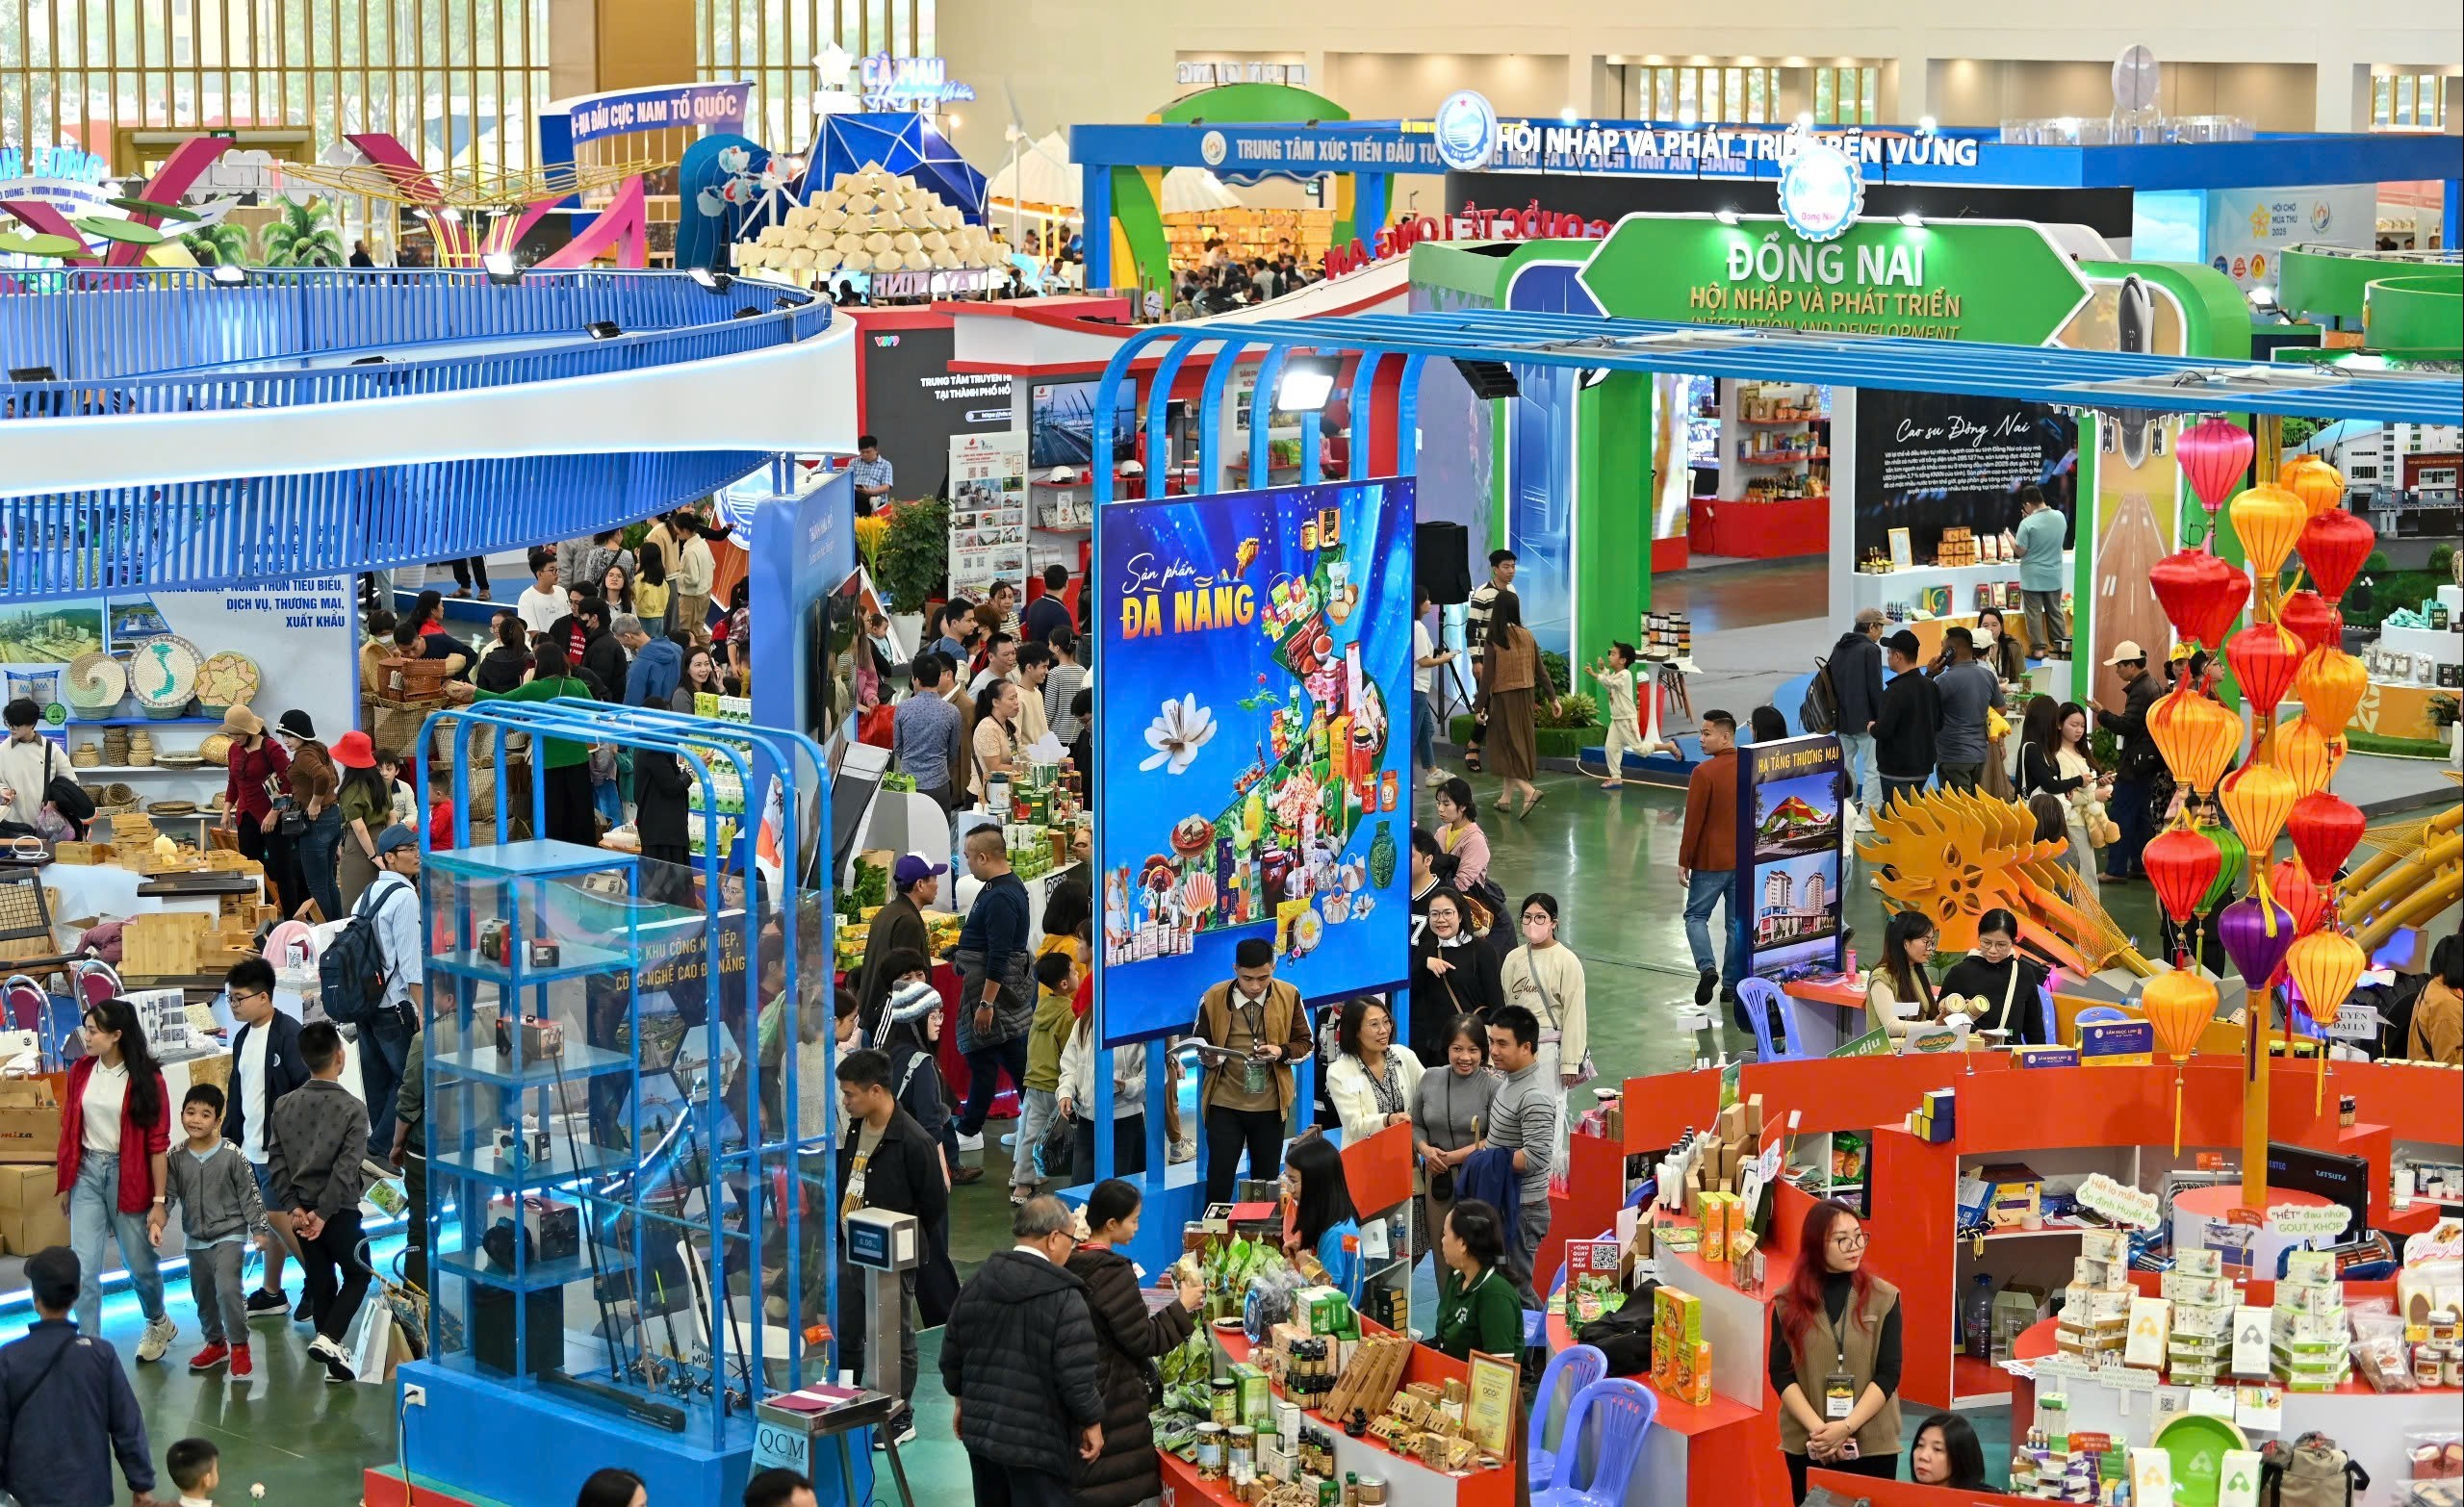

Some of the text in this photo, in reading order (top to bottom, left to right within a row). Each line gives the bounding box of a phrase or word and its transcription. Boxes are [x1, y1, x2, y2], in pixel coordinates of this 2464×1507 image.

[861, 50, 946, 88] CÀ MAU
[592, 101, 608, 130] ĐẦU
[611, 102, 633, 129] CỰC
[637, 100, 667, 122] NAM
[671, 89, 691, 119] TỔ
[694, 89, 737, 119] QUỐC
[1237, 138, 1281, 159] TRUNG
[1285, 136, 1315, 160] TÂM
[1319, 137, 1347, 162] XÚC
[1350, 136, 1382, 162] TIẾN
[1386, 136, 1415, 163] ĐẦU
[1496, 120, 1541, 160] HỘI
[1546, 121, 1620, 162] NHẬP
[1625, 122, 1657, 157] VÀ
[1664, 124, 1732, 159] PHÁT
[1888, 130, 1977, 166] VỮNG
[35, 146, 104, 186] LONG
[2272, 228, 2286, 237] 2025
[1727, 231, 1924, 287] ĐỒNG NAI
[1690, 281, 1962, 318] HỘI NHẬP VÀ PHÁT TRIỂN
[920, 374, 969, 387] TRUNG TÂM
[935, 384, 997, 400] TẠI THÀNH PHỐ
[1896, 412, 2031, 447] Cao su Đồng Nai
[318, 575, 345, 592] BIỂU,
[1122, 552, 1197, 594] Sản phẩm
[227, 598, 344, 612] DỊCH VỤ, THƯƠNG MẠI,
[286, 610, 345, 627] XUẤT KHẨU
[1120, 577, 1255, 639] ĐÀ NẴNG
[1758, 746, 1838, 775] HẠ TẦNG THƯƠNG MẠI
[645, 936, 697, 961] KHU CÔNG
[616, 947, 746, 991] CÔG NGHỆ CAO NẴNG
[2333, 1022, 2368, 1032] ĐẠI LÝ
[1859, 1036, 1881, 1055] dịu
[2269, 1160, 2347, 1182] ESTEC TATSUTA
[2091, 1179, 2107, 1190] Hết
[2118, 1189, 2136, 1202] mất
[2138, 1196, 2153, 1209] ngủ
[2095, 1197, 2115, 1210] định
[2117, 1204, 2142, 1218] Huyết
[2272, 1209, 2300, 1219] "HẾT"
[2313, 1221, 2343, 1231] KHỚP
[760, 1429, 805, 1460] QCM
